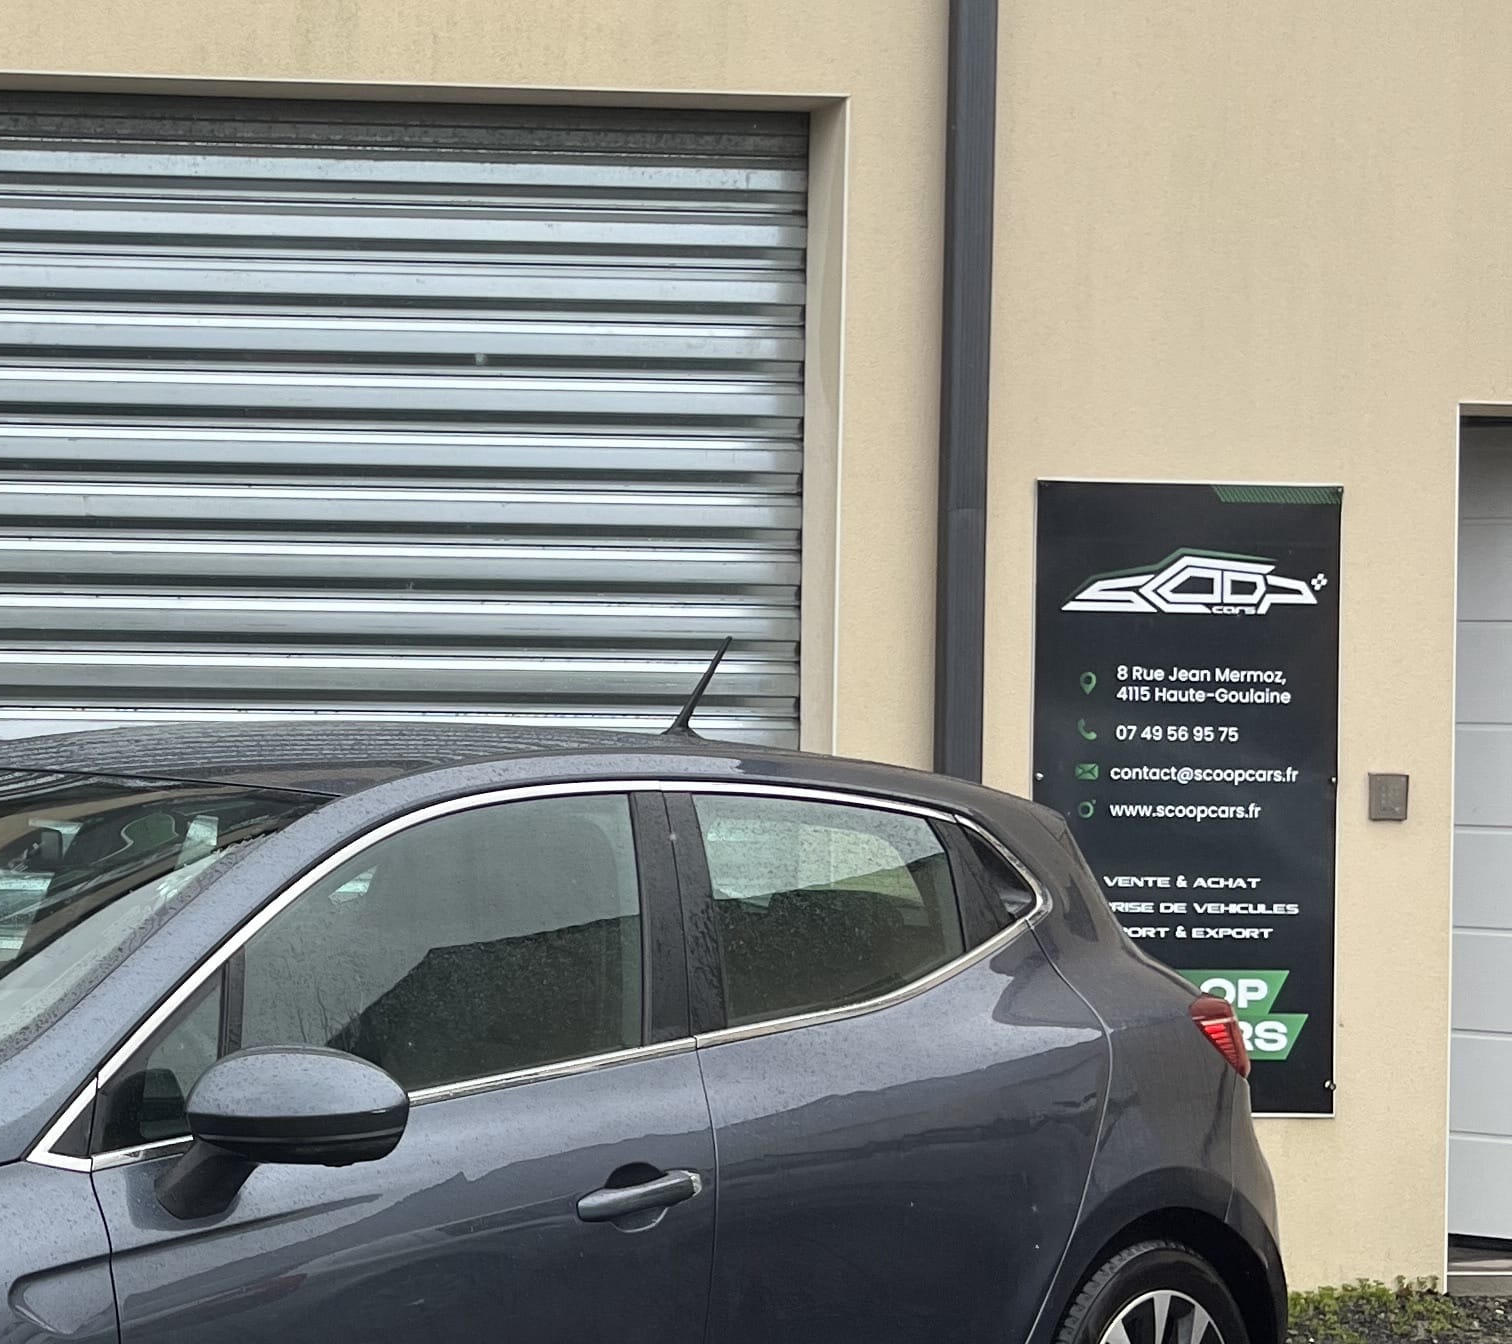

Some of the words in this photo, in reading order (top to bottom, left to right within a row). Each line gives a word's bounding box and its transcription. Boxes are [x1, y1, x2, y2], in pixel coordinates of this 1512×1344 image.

[1211, 605, 1257, 616] cars
[1116, 665, 1127, 681] 8
[1132, 666, 1164, 682] Rue
[1169, 667, 1210, 682] Jean
[1215, 667, 1286, 685] Mermoz,
[1116, 687, 1151, 703] 4115
[1155, 687, 1291, 705] Haute-Goulaine
[1115, 725, 1136, 741] 07
[1141, 725, 1163, 741] 49
[1167, 726, 1189, 741] 56
[1193, 726, 1215, 742] 95
[1219, 726, 1239, 742] 75
[1110, 766, 1300, 785] contact@scoopcars.fr
[1110, 802, 1262, 822] www.scoopcars.fr
[1104, 876, 1171, 888] VENTE
[1176, 875, 1188, 888] &
[1193, 877, 1261, 889] ACHAT
[1109, 901, 1155, 914] RISE
[1159, 902, 1187, 914] DE
[1193, 902, 1300, 915] VEHICULES
[1123, 927, 1170, 939] ORT
[1176, 925, 1187, 938] &
[1192, 927, 1274, 939] EXPORT
